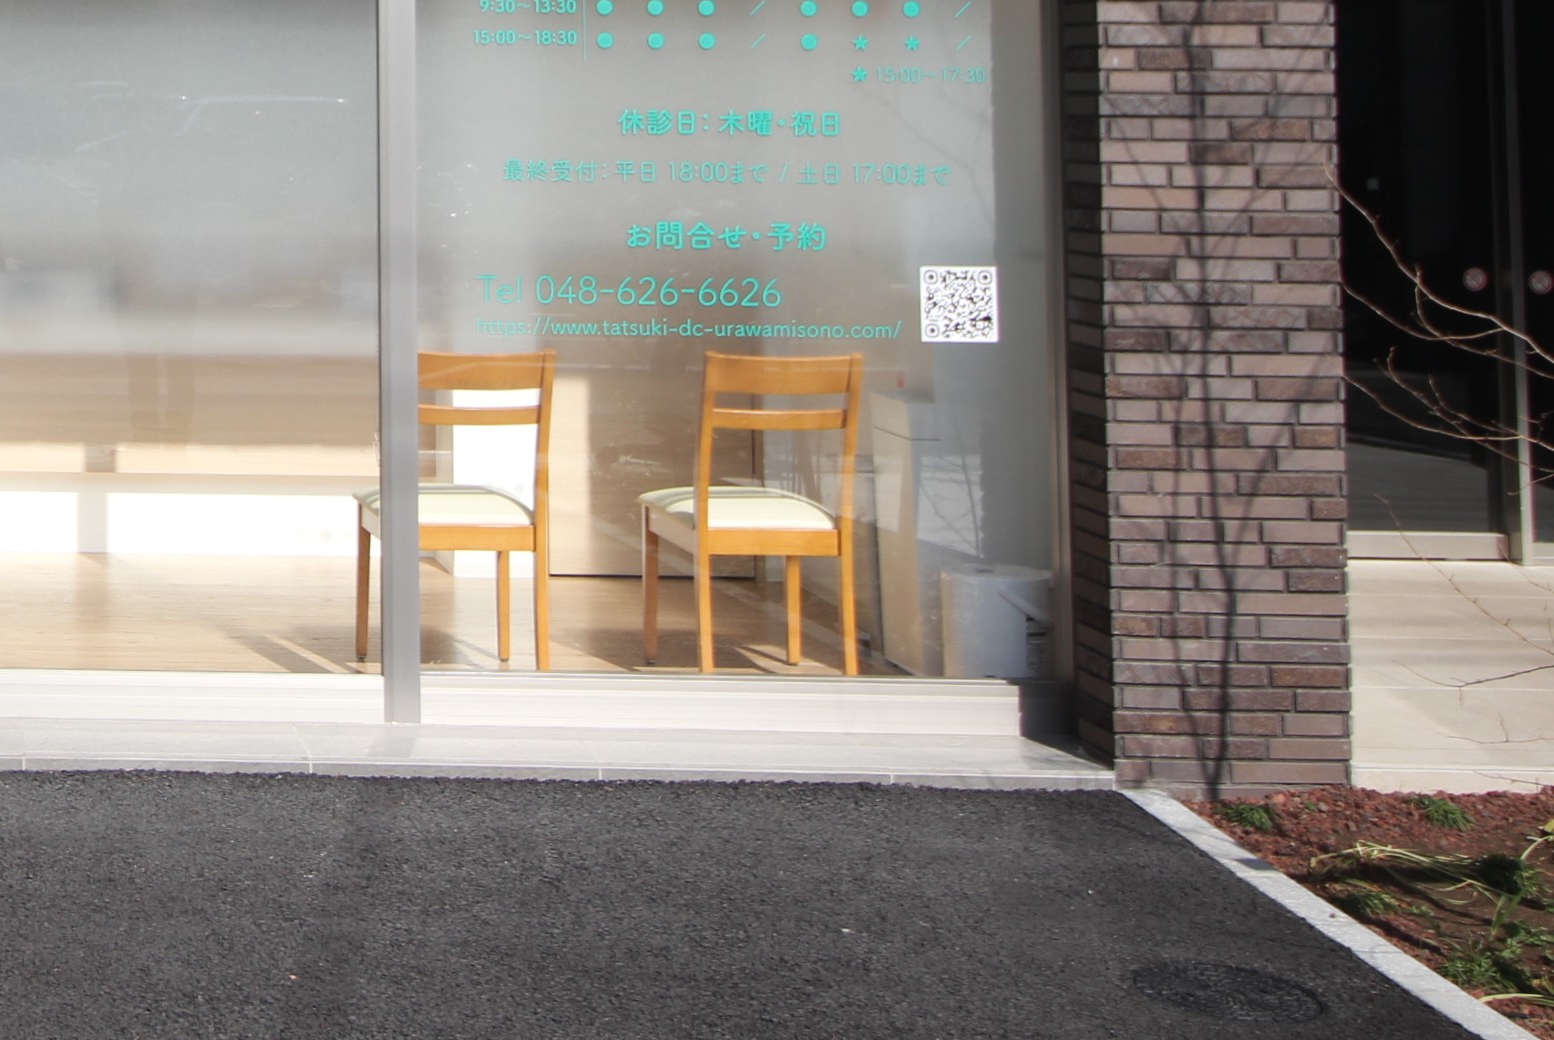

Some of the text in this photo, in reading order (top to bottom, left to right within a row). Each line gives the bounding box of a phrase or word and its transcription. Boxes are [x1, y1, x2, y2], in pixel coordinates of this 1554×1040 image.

[669, 160, 769, 185] 18:00まで
[798, 162, 842, 185] 土日
[854, 162, 952, 186] 17:00まで
[626, 221, 828, 252] お問合せ・予約
[476, 273, 784, 308] Tel 048-626-6626
[476, 316, 903, 340] https://www.tatsuki-dc-urawamisono.com/
